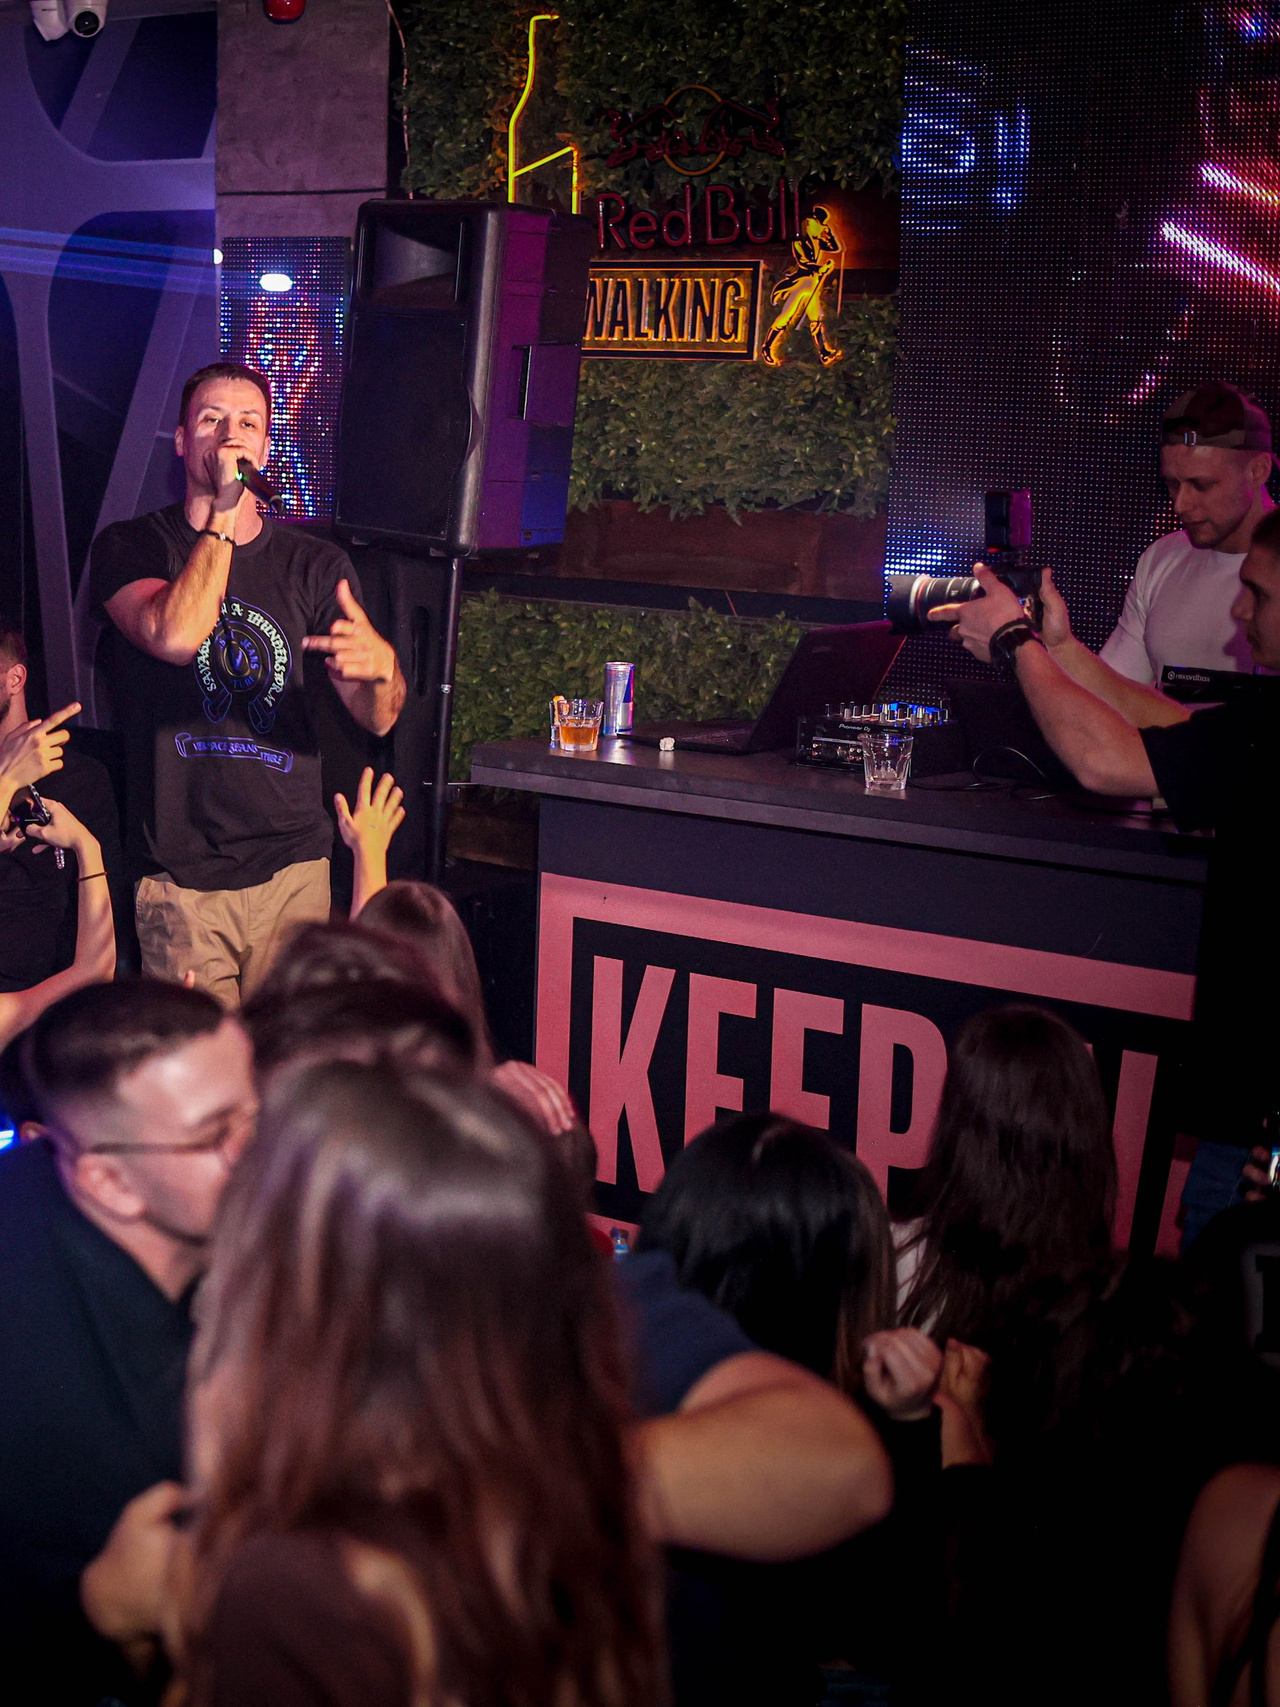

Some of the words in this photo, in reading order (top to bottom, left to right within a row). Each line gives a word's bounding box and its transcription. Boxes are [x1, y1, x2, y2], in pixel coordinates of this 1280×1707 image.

[597, 183, 692, 250] Red
[706, 177, 803, 246] Bull
[582, 277, 747, 343] WALKING
[588, 955, 948, 1203] KEEP
